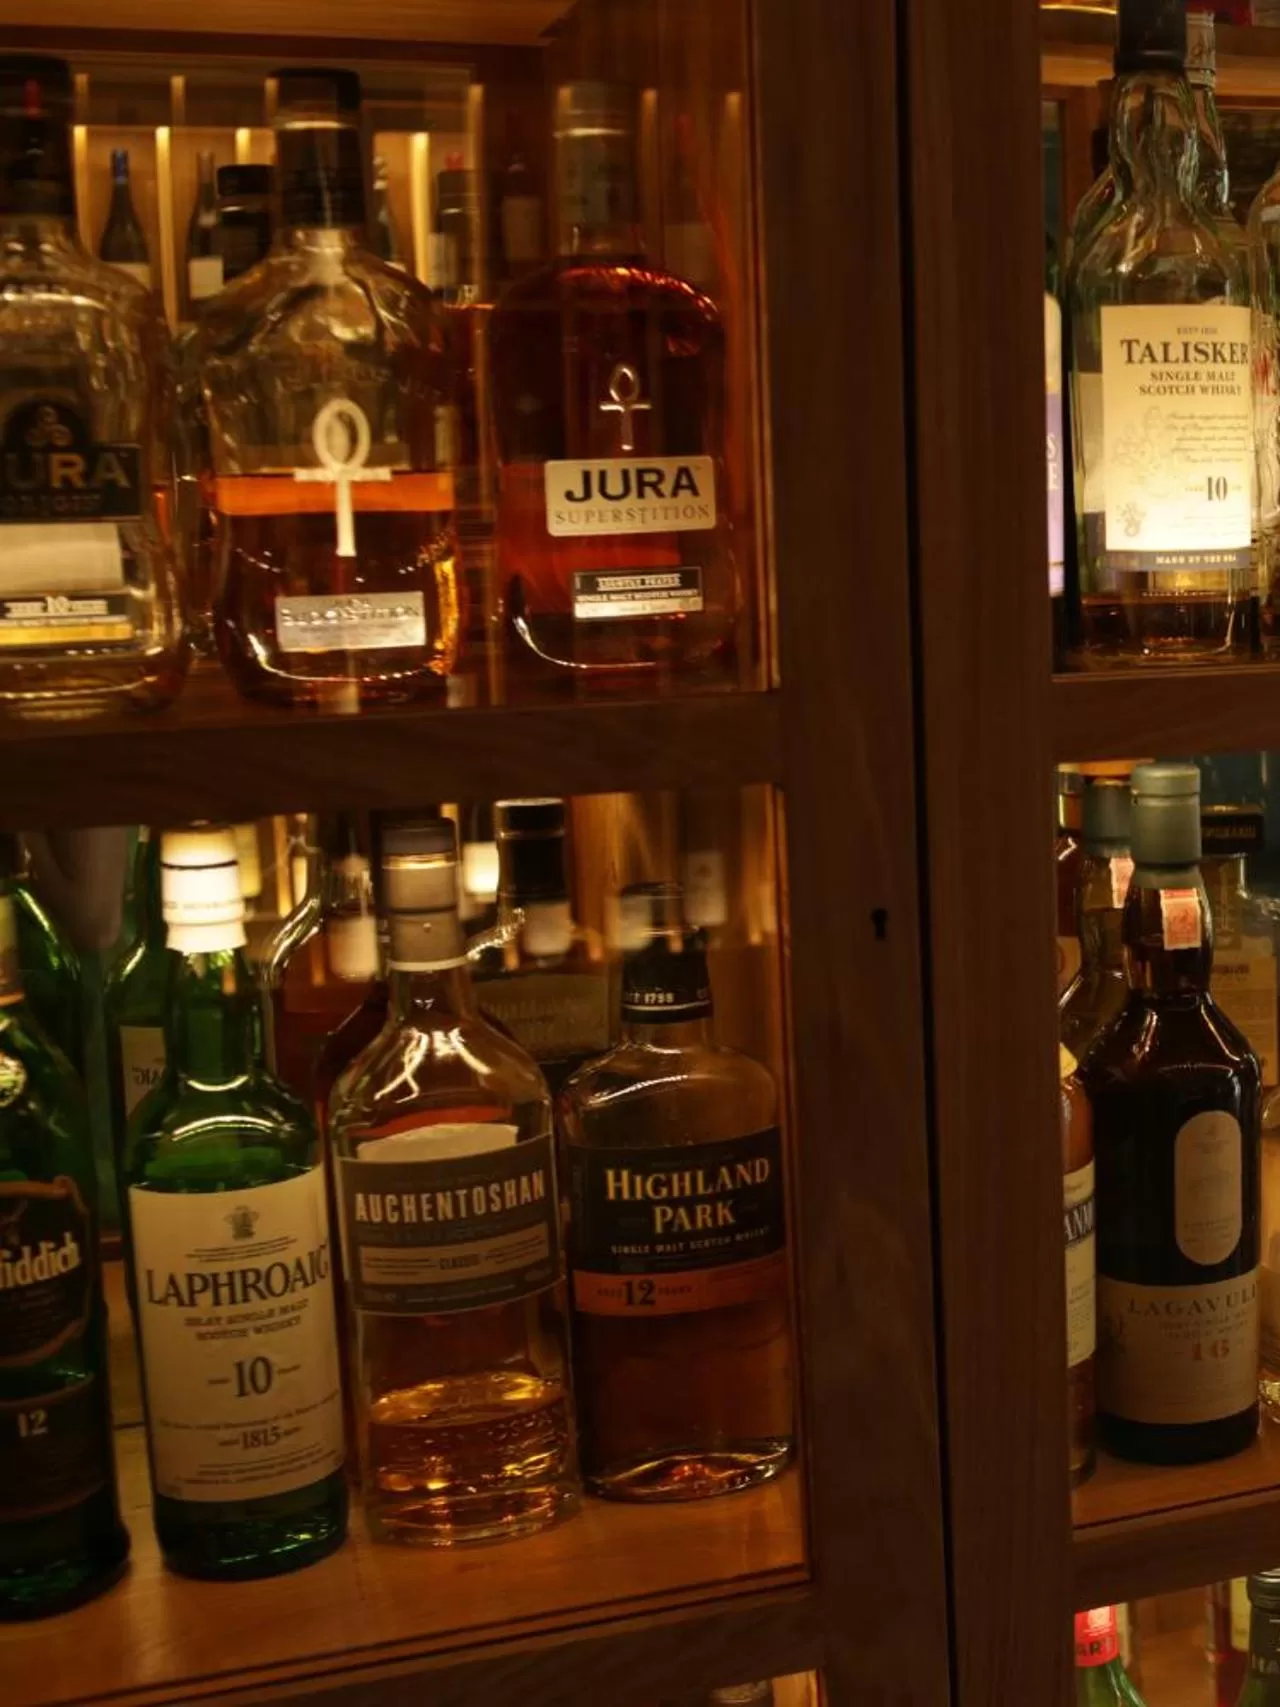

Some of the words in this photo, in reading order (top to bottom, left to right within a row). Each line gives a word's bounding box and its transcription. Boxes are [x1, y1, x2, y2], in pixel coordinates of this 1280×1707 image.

[1119, 337, 1248, 366] TALISKER
[1139, 383, 1195, 396] SCOTCH
[1149, 370, 1202, 382] SINGLE
[4, 451, 132, 489] URA
[564, 466, 700, 503] JURA
[1205, 475, 1229, 502] 10
[555, 504, 710, 525] SUPERSTITION
[605, 1157, 770, 1200] HIGHLAND
[355, 1169, 546, 1224] AUCHENTOSHAN
[653, 1200, 736, 1235] PARK
[146, 1244, 328, 1309] LAPHROAIG
[623, 1279, 656, 1306] 12
[232, 1355, 274, 1398] 10
[17, 1408, 49, 1438] 12
[241, 1425, 281, 1450] 1815
